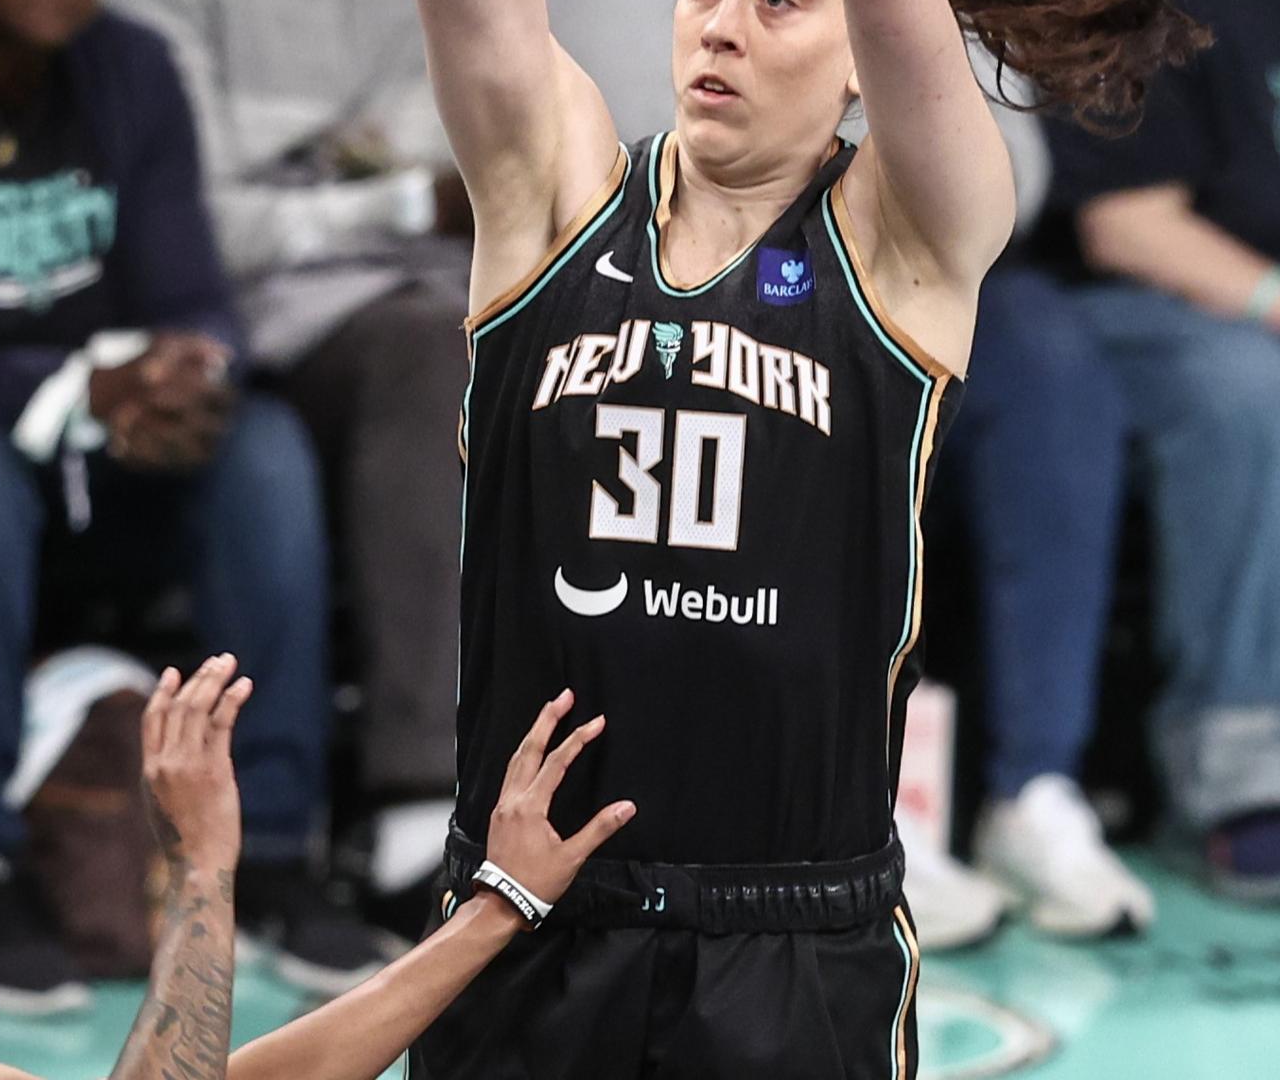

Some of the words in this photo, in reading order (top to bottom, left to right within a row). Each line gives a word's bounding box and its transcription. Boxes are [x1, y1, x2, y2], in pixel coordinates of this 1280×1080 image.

[531, 319, 652, 411] NEW
[691, 320, 832, 437] YORK
[588, 402, 748, 552] 30
[643, 579, 778, 625] Webull
